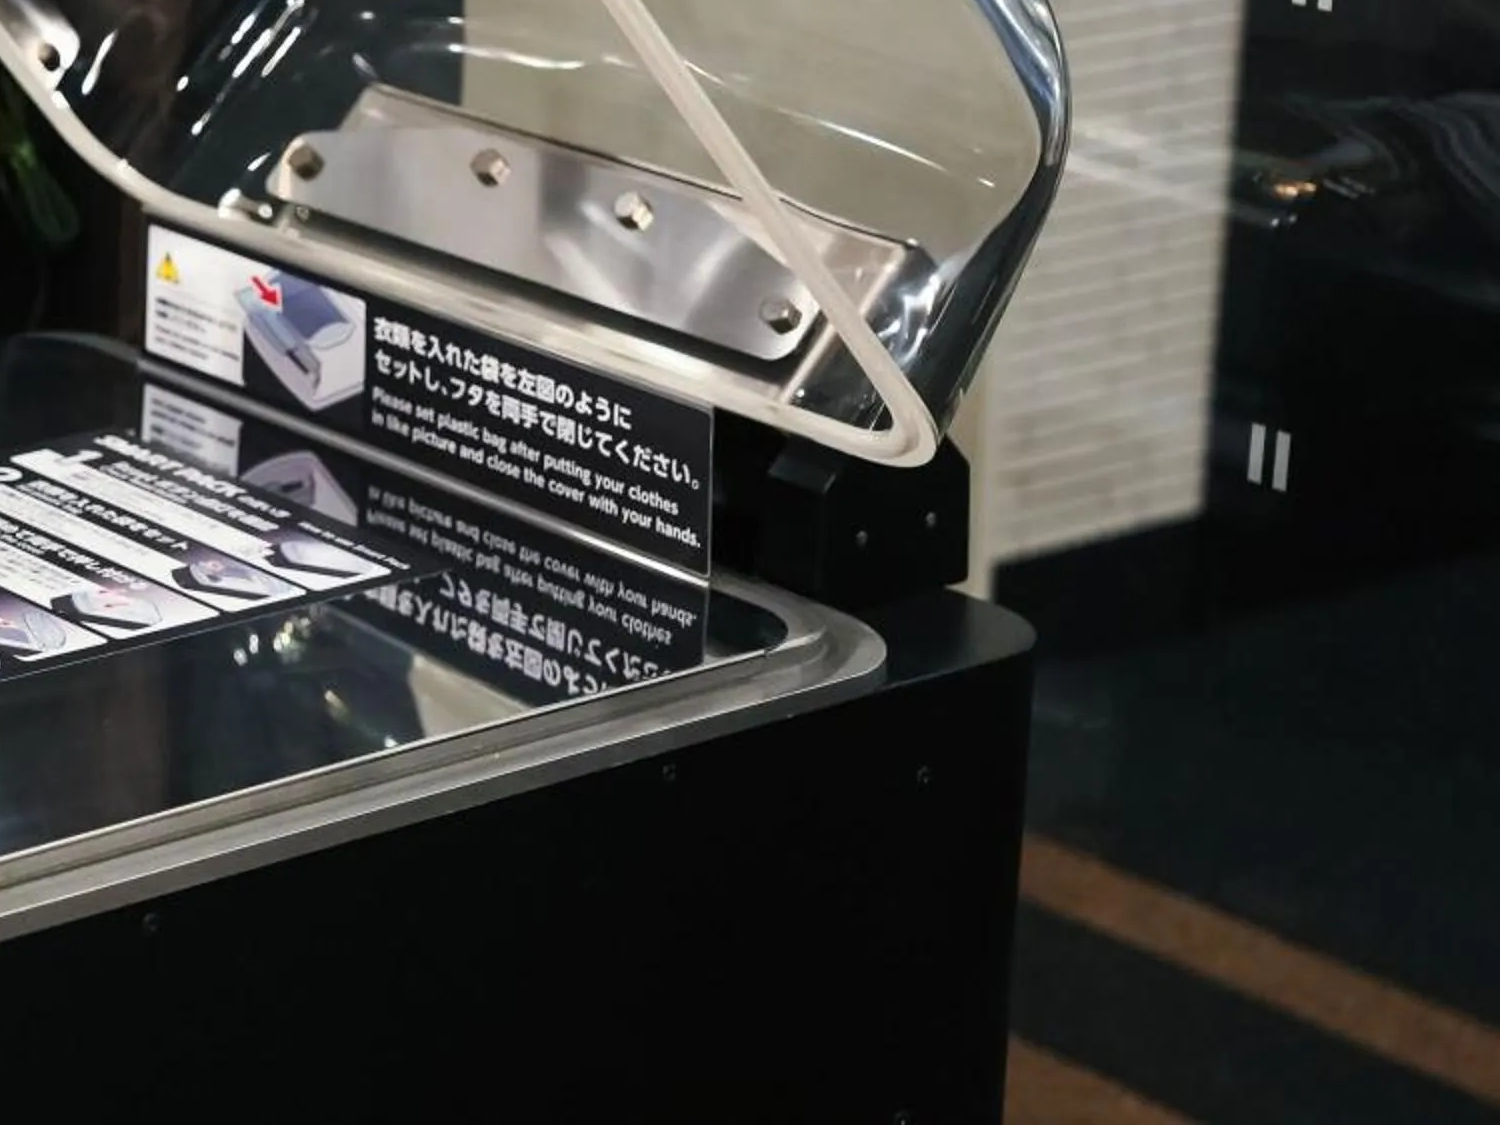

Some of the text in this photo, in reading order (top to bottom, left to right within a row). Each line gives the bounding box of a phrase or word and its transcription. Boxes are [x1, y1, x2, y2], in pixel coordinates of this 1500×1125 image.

[374, 317, 632, 430] 衣類を入れた袋を左図のように
[372, 386, 679, 515] Please set plastic bag after putting your clothes
[412, 427, 457, 454] picture
[460, 445, 484, 464] and
[486, 455, 521, 479] close
[523, 467, 545, 488] the
[548, 479, 585, 503] cover
[588, 494, 618, 516] with
[622, 507, 652, 528] your
[656, 516, 700, 548] hands.
